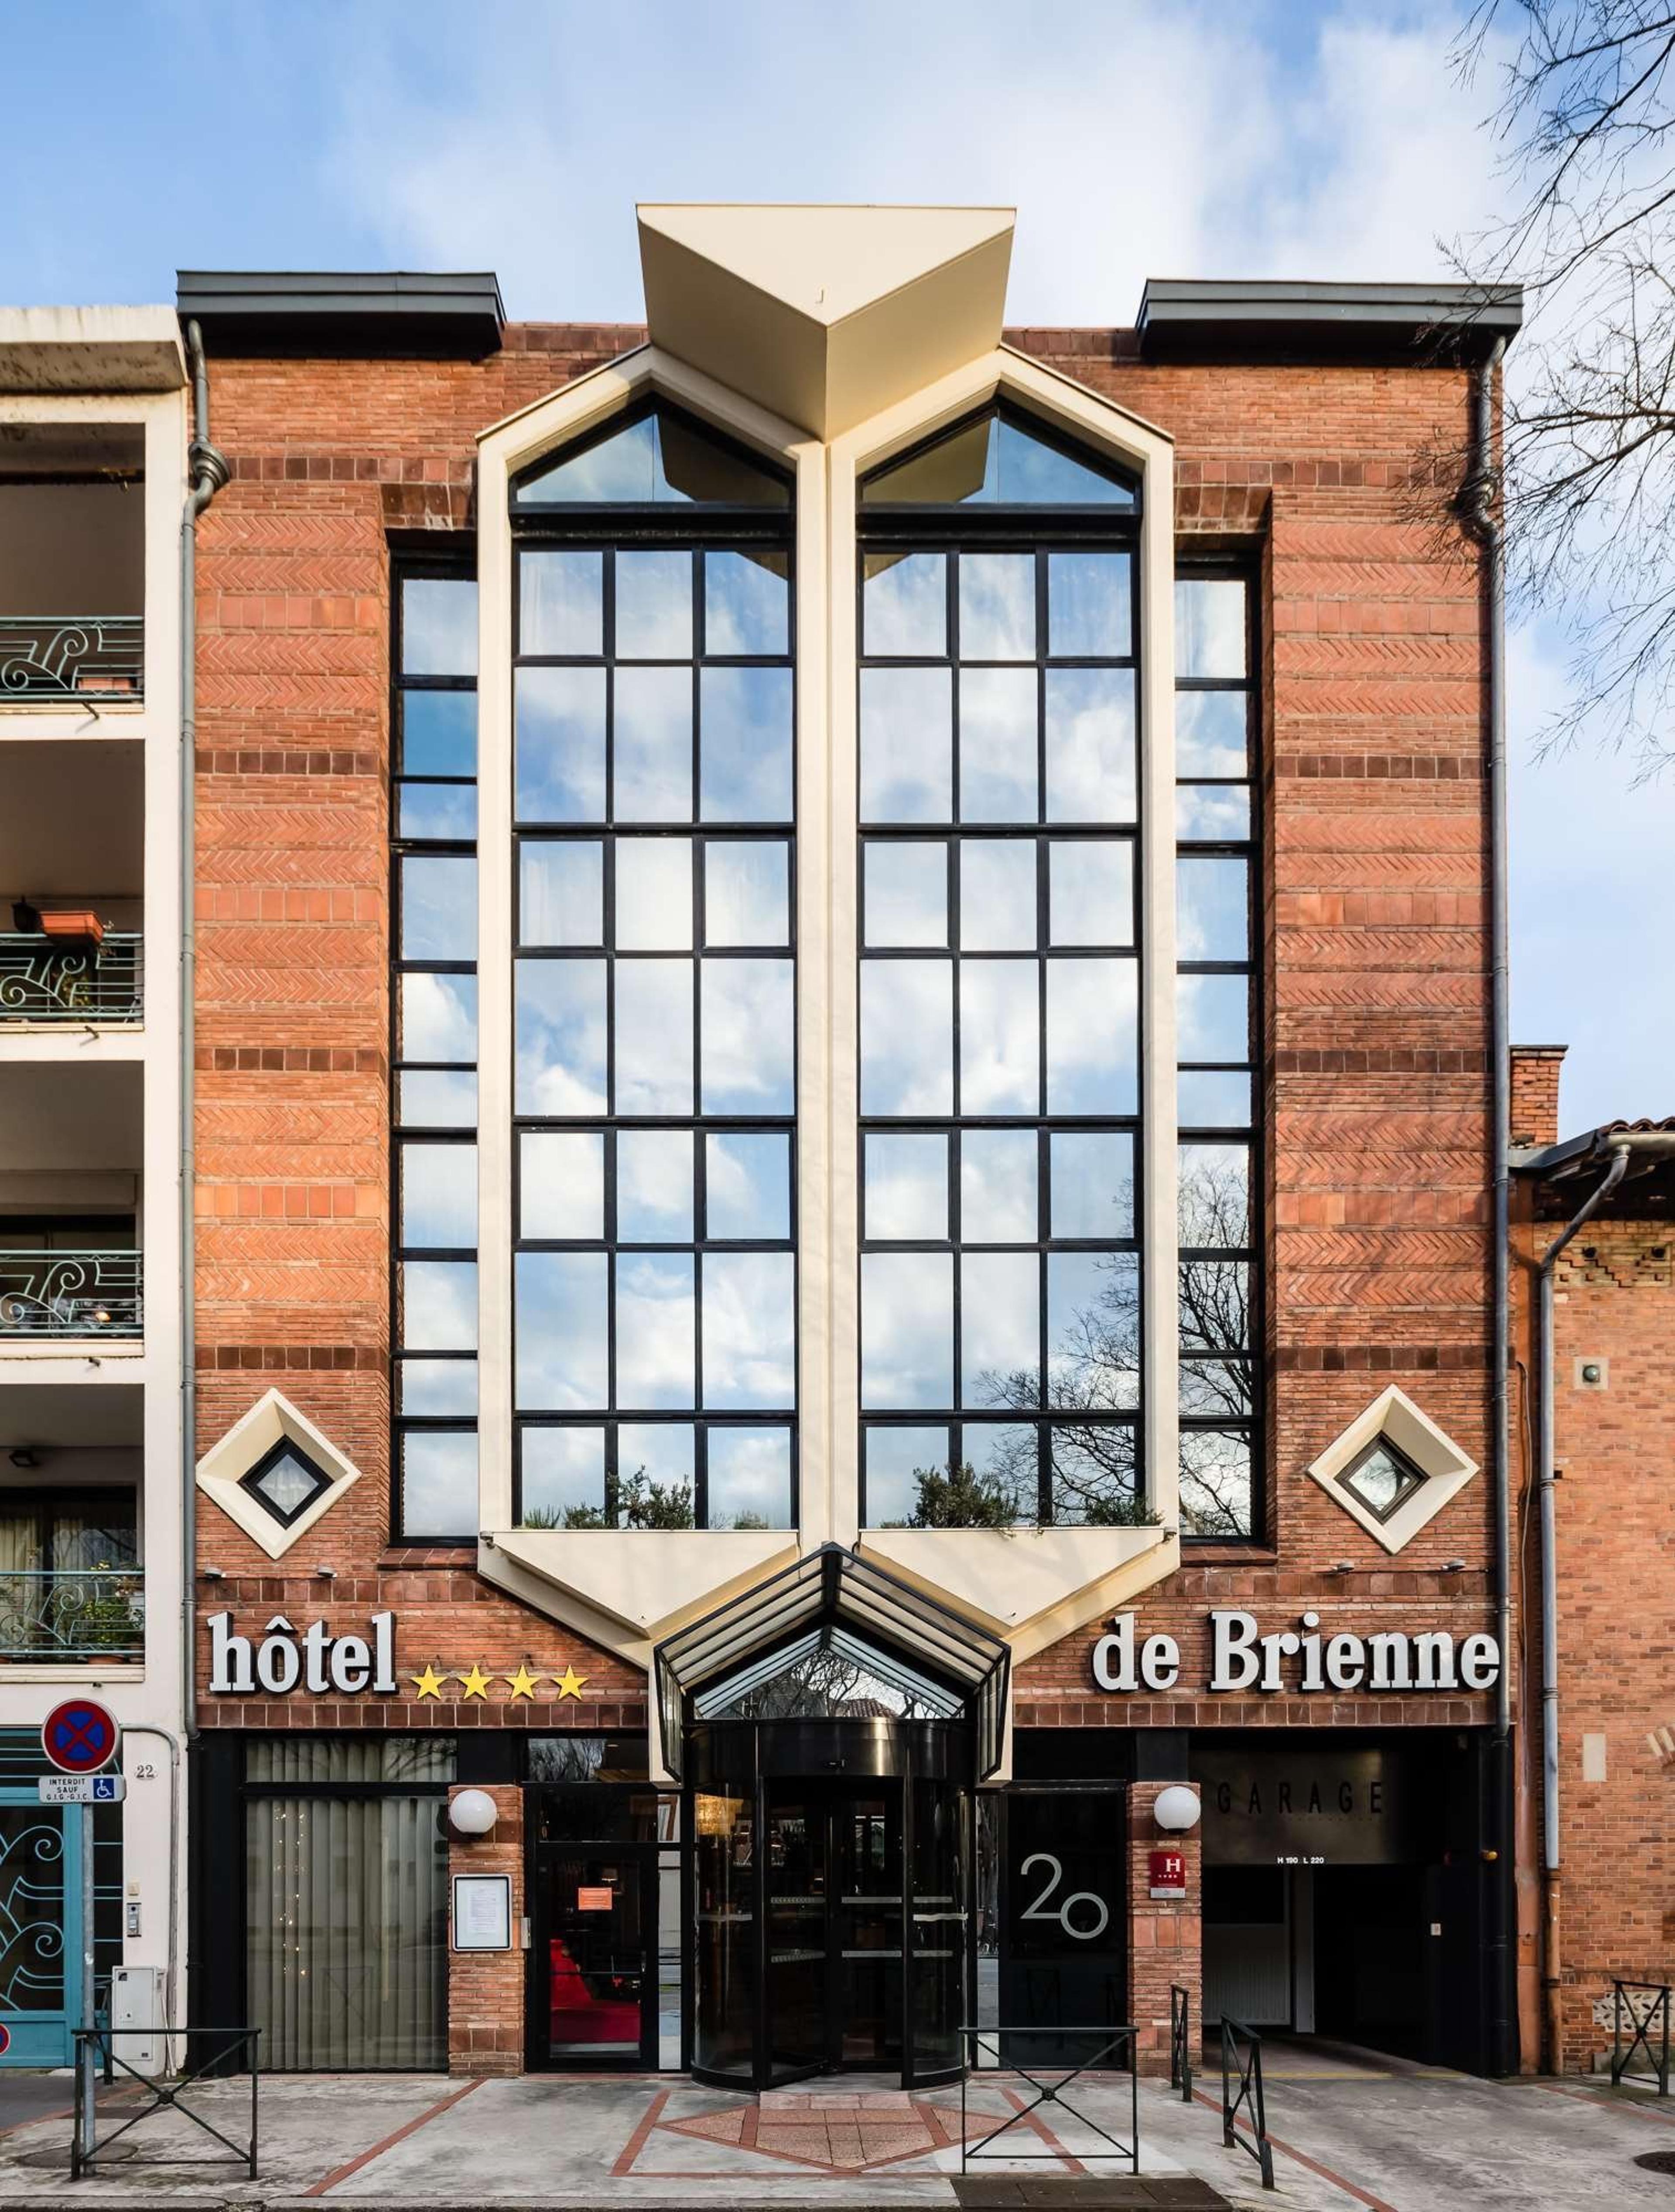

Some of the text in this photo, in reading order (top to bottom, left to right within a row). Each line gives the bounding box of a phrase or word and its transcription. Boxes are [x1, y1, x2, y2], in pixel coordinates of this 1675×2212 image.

[207, 1611, 1501, 1693] hôtel de Brienne
[136, 1765, 155, 1778] 22
[1217, 1781, 1382, 1814] GARAGE
[1166, 1858, 1180, 1872] H
[1020, 1854, 1108, 1939] 20
